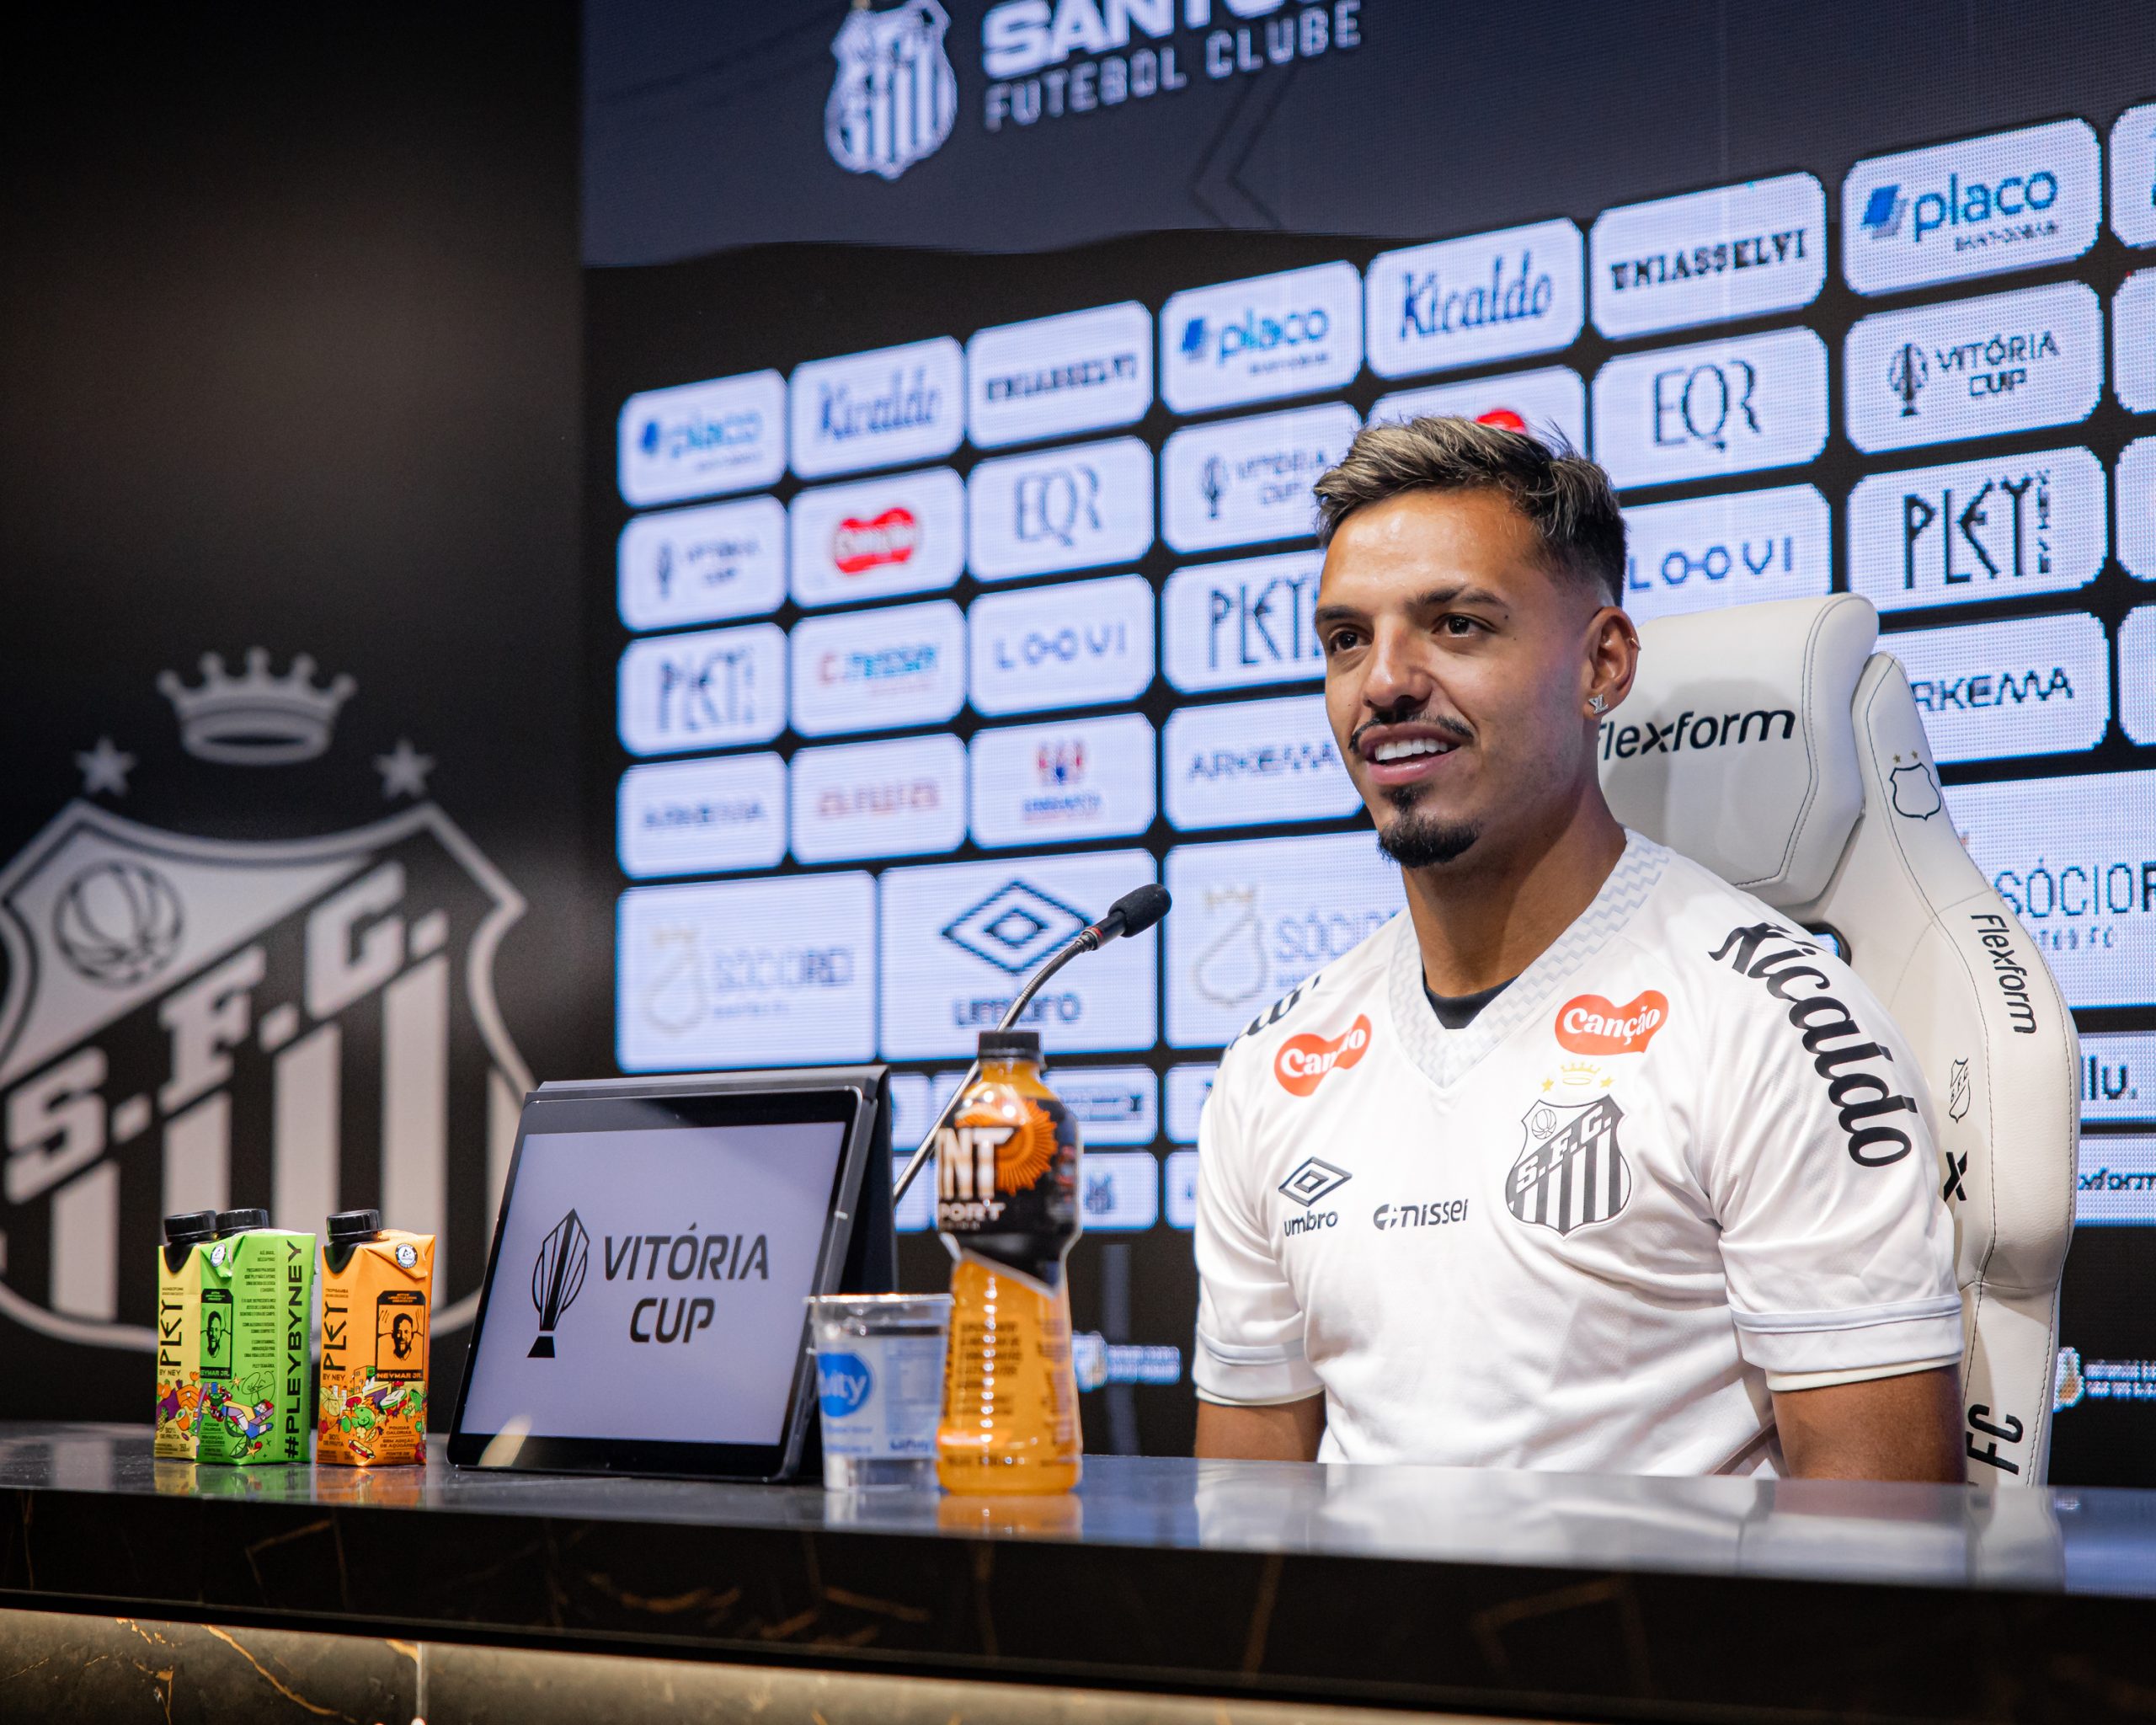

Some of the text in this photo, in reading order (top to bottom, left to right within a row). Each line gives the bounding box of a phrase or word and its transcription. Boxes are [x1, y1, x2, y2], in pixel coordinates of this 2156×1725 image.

[982, 0, 1322, 80] SAN
[984, 0, 1362, 132] FUTEBOL CLUBE
[1913, 171, 2058, 243] placo
[1401, 250, 1552, 341] Kicaldo
[1935, 330, 2061, 373] VITÓRIA
[1968, 367, 2027, 398] CUP
[1652, 359, 1761, 453] EQR
[1904, 477, 2033, 590] PLEY
[1913, 665, 2075, 713] RKEMA
[1970, 914, 2037, 1033] Flexform
[7, 859, 450, 1205] S.F.C.
[1279, 1028, 1367, 1079] Cano
[1562, 1005, 1661, 1046] Canção
[1707, 921, 1919, 1167] Kicaldo
[937, 1127, 1014, 1200] NT
[1516, 1104, 1613, 1194] S.F.C.
[604, 1221, 769, 1281] VITÓRIA
[1283, 1210, 1339, 1237] umbro
[160, 1299, 184, 1366] PLEY
[284, 1240, 303, 1459] #PLEYBYNEY
[323, 1300, 349, 1371] PLEY
[629, 1297, 715, 1344] CUP
[1966, 1403, 2024, 1476] FC
